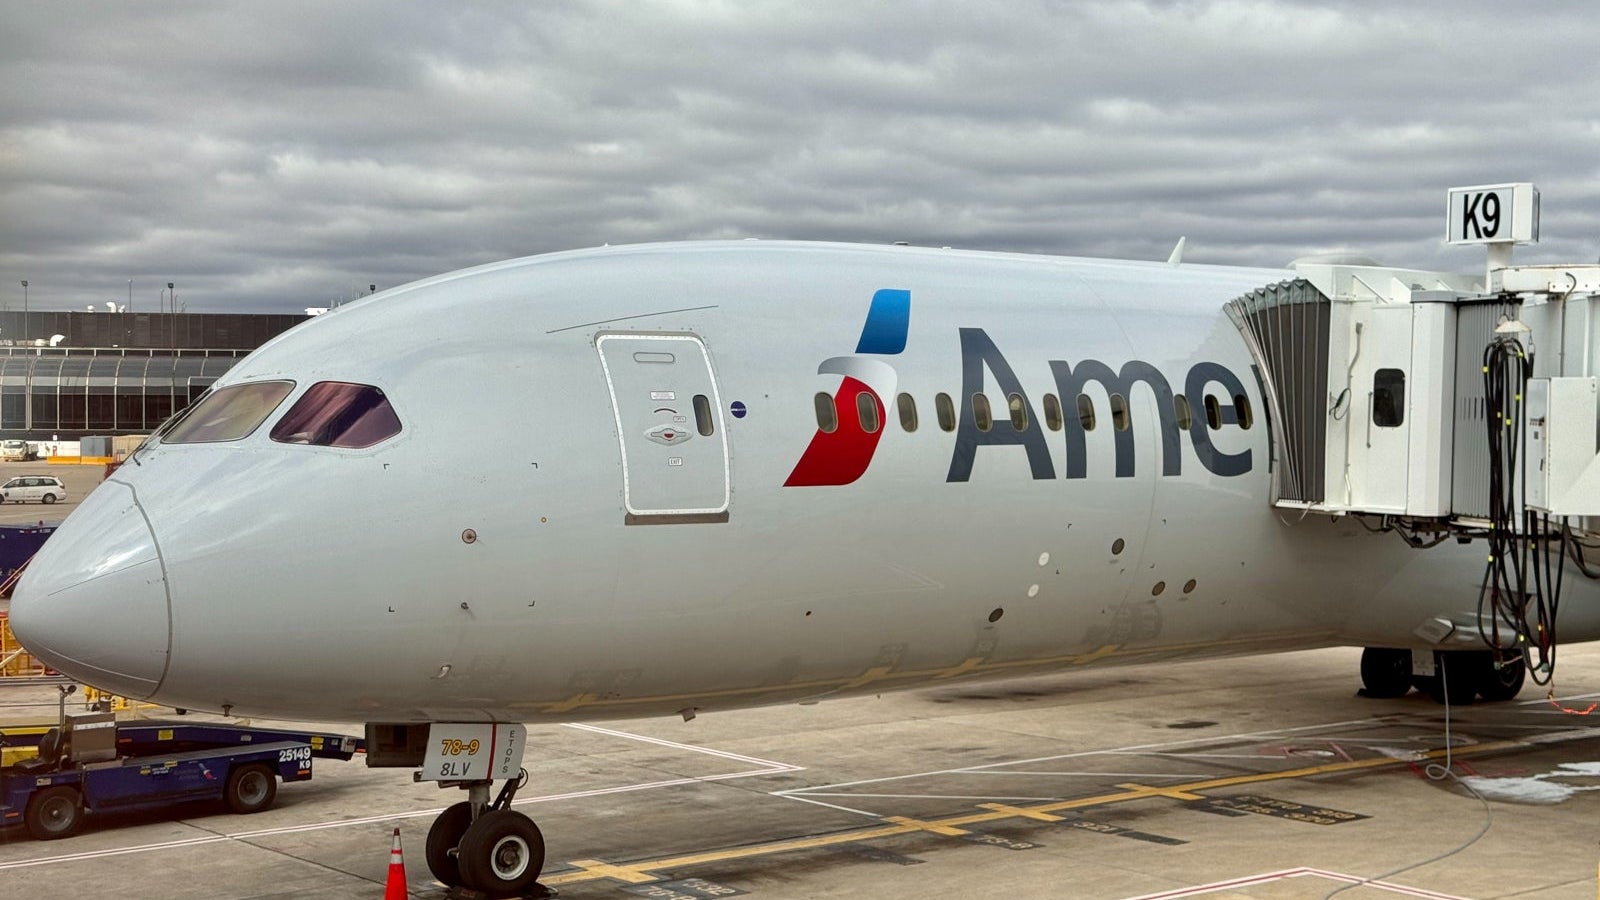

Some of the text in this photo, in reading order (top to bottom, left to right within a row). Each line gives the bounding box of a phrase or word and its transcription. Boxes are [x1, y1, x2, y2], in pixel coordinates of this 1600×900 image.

[1462, 192, 1501, 240] K9
[946, 327, 1274, 483] Ame
[279, 747, 311, 763] 25149
[441, 739, 480, 756] 78-9
[502, 730, 515, 774] ETOPS
[299, 760, 311, 769] K9
[440, 762, 471, 777] 8LV
